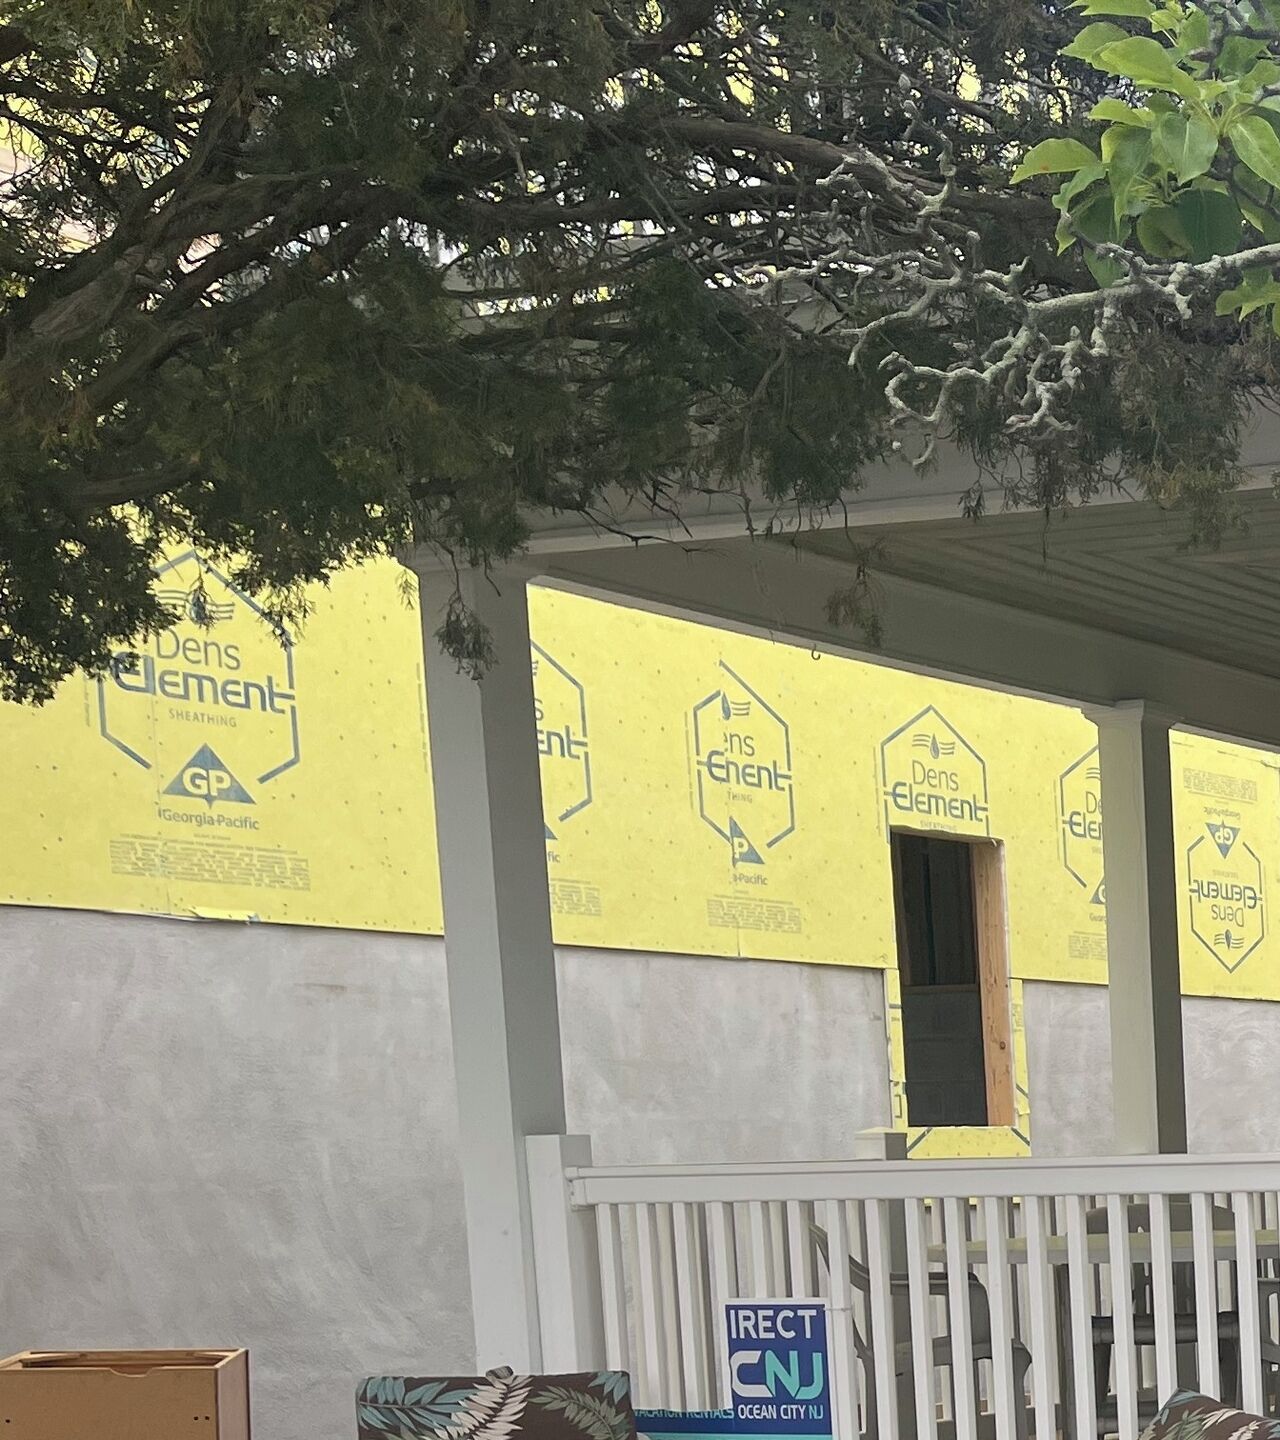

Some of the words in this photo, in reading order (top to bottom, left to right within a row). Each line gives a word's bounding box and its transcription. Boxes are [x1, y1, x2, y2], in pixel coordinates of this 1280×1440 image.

[155, 628, 241, 671] Dens
[110, 652, 295, 715] Element
[168, 708, 238, 728] SHEATHING
[182, 767, 232, 796] GP
[912, 760, 959, 792] Dens
[884, 781, 988, 822] Element
[1189, 879, 1262, 909] Element
[1211, 904, 1245, 928] Dens
[729, 1309, 817, 1339] IRECT
[737, 1404, 777, 1419] OCEAN
[780, 1405, 806, 1419] CITY
[808, 1405, 824, 1420] NJ
